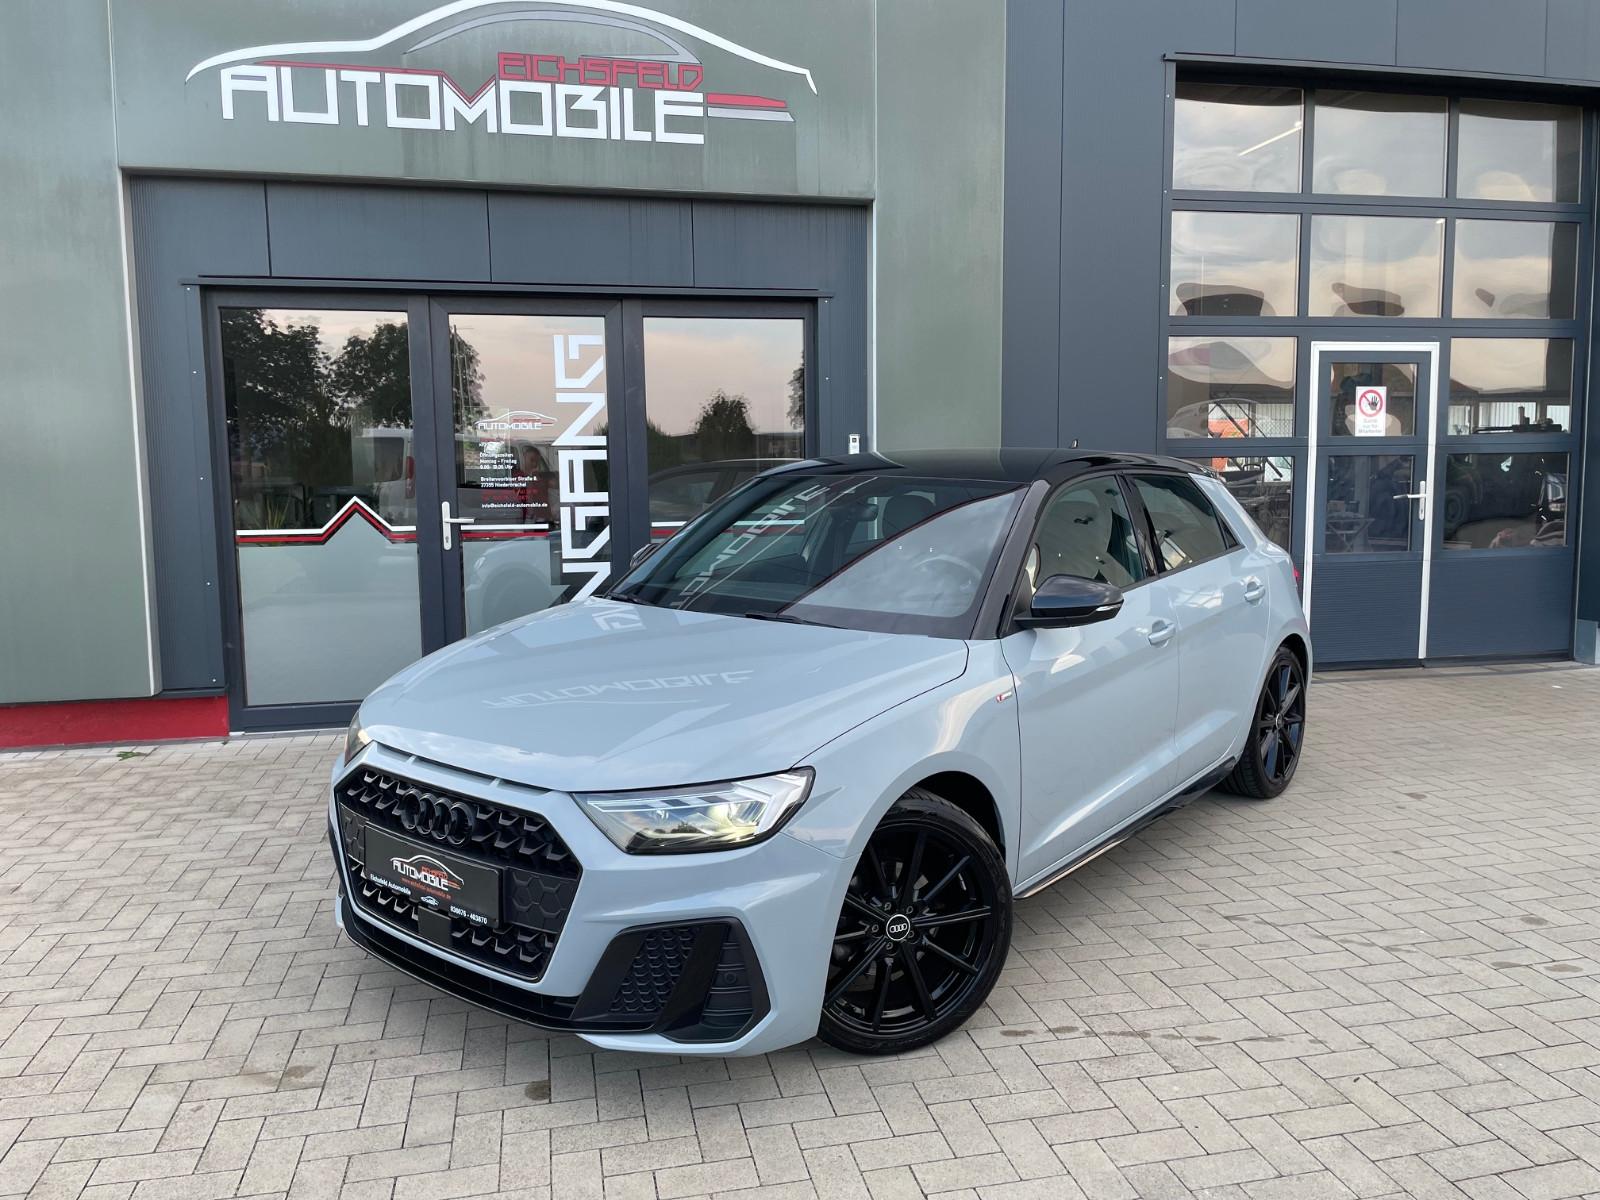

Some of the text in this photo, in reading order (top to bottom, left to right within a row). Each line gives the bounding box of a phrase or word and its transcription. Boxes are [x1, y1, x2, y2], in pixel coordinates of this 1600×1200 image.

[498, 52, 703, 92] EICHSFELD
[220, 64, 705, 145] AUTOMOBILE
[478, 422, 543, 430] AUTOMOBILE
[392, 860, 449, 892] AUTOMOBILE
